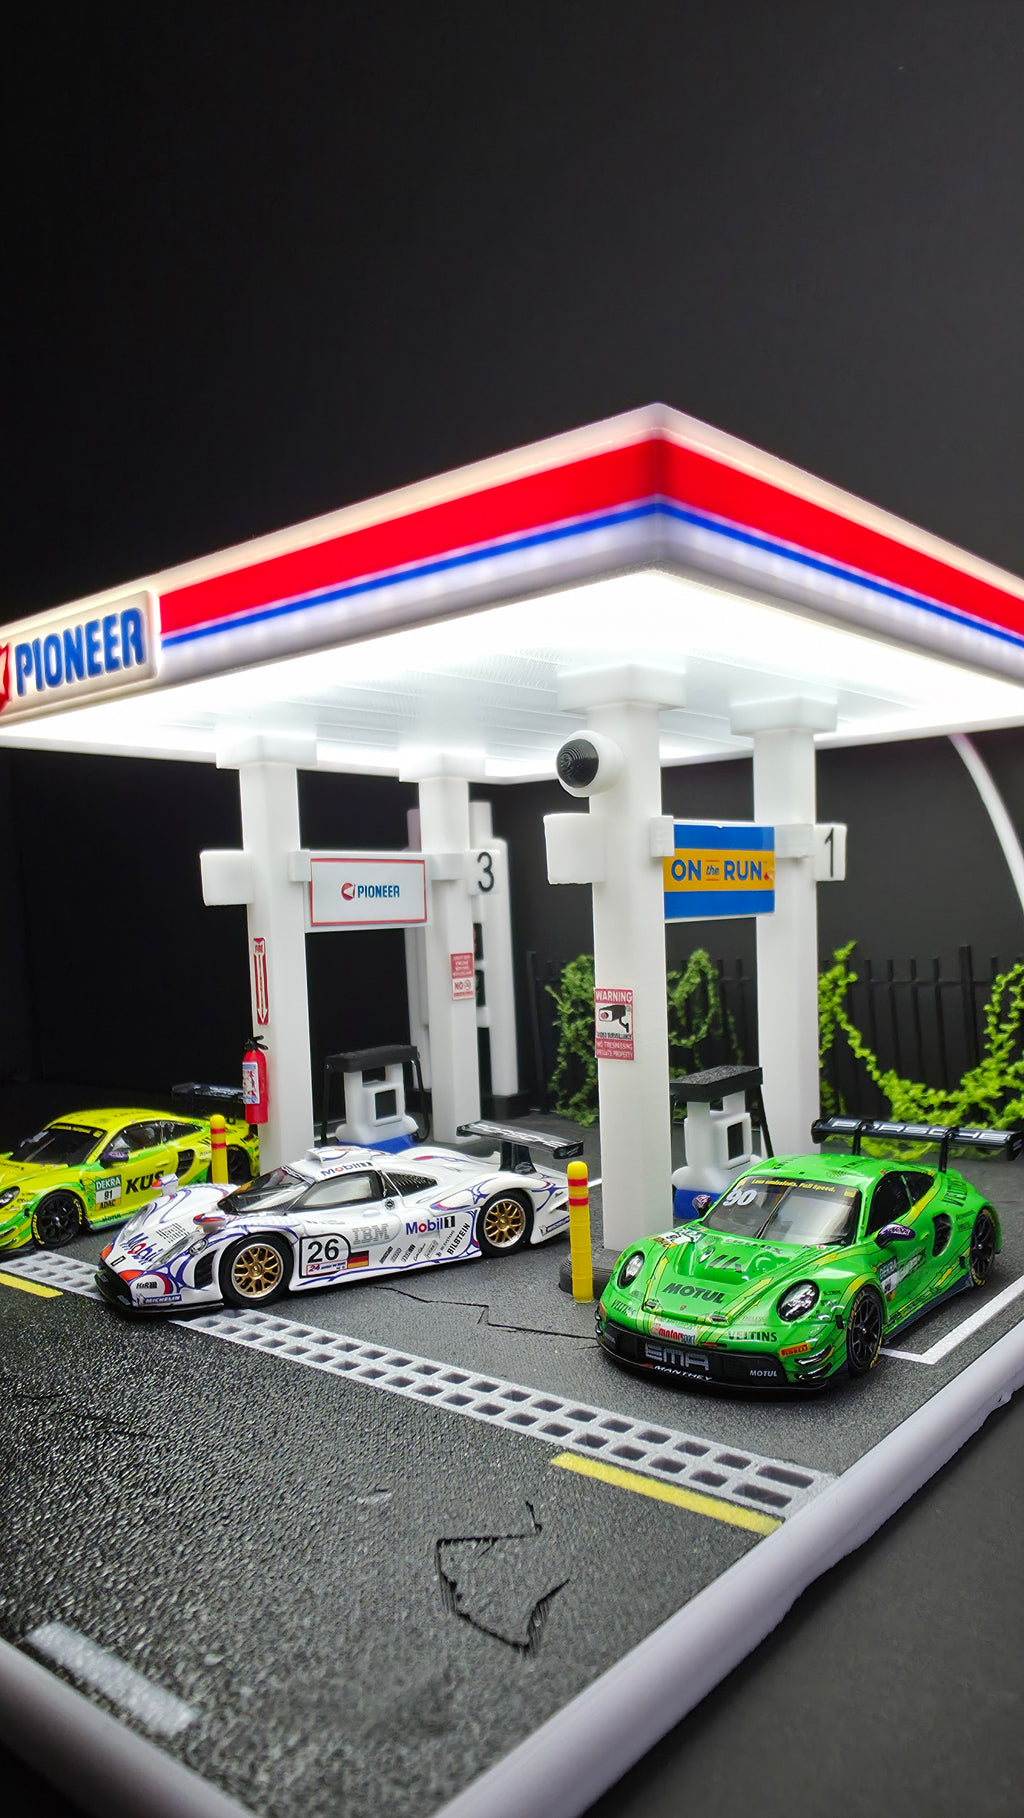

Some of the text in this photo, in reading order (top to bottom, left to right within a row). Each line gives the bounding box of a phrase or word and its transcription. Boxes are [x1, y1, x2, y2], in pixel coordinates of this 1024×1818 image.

[15, 607, 146, 697] PIONEER
[824, 828, 834, 878] 1
[477, 851, 494, 892] 3
[671, 859, 762, 881] ON the RUN
[357, 885, 400, 899] PIONEER
[596, 990, 632, 1003] WARNING
[96, 1177, 121, 1191] DEKRA
[104, 1189, 113, 1200] 91
[722, 1189, 757, 1206] 90
[352, 1223, 389, 1245] IBM
[405, 1218, 443, 1235] Mobil
[446, 1222, 471, 1255] BILSTEIN
[119, 1232, 164, 1266] Mobil
[308, 1238, 340, 1263] 26
[145, 1295, 181, 1304] MICHELIN
[662, 1282, 726, 1304] MOTUL
[728, 1330, 778, 1343] VELTINS
[654, 1364, 712, 1381] MANTHEY
[749, 1368, 778, 1378] MOTUL
